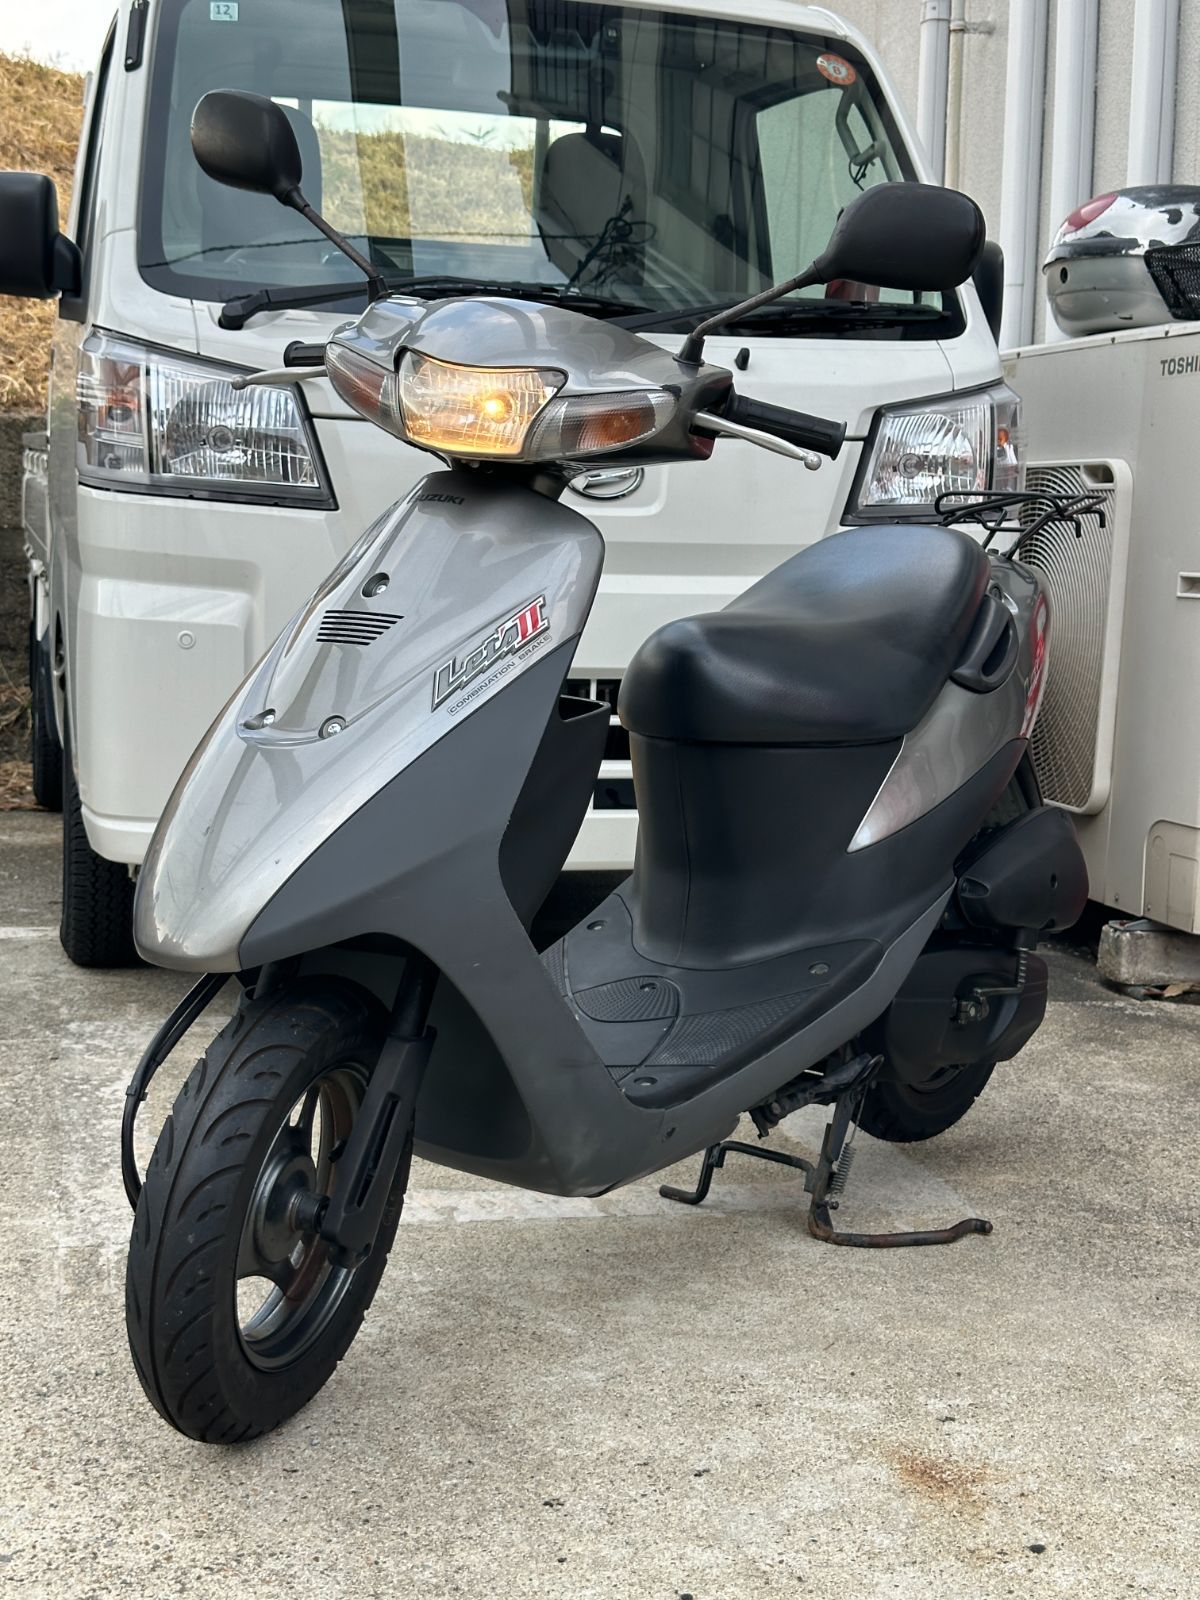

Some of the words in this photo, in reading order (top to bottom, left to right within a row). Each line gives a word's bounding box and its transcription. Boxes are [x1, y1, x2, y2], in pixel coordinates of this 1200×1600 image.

[216, 4, 231, 16] 12
[1160, 355, 1200, 376] TOSHI
[449, 660, 516, 714] COMBINATION
[518, 634, 551, 661] BRAKE
